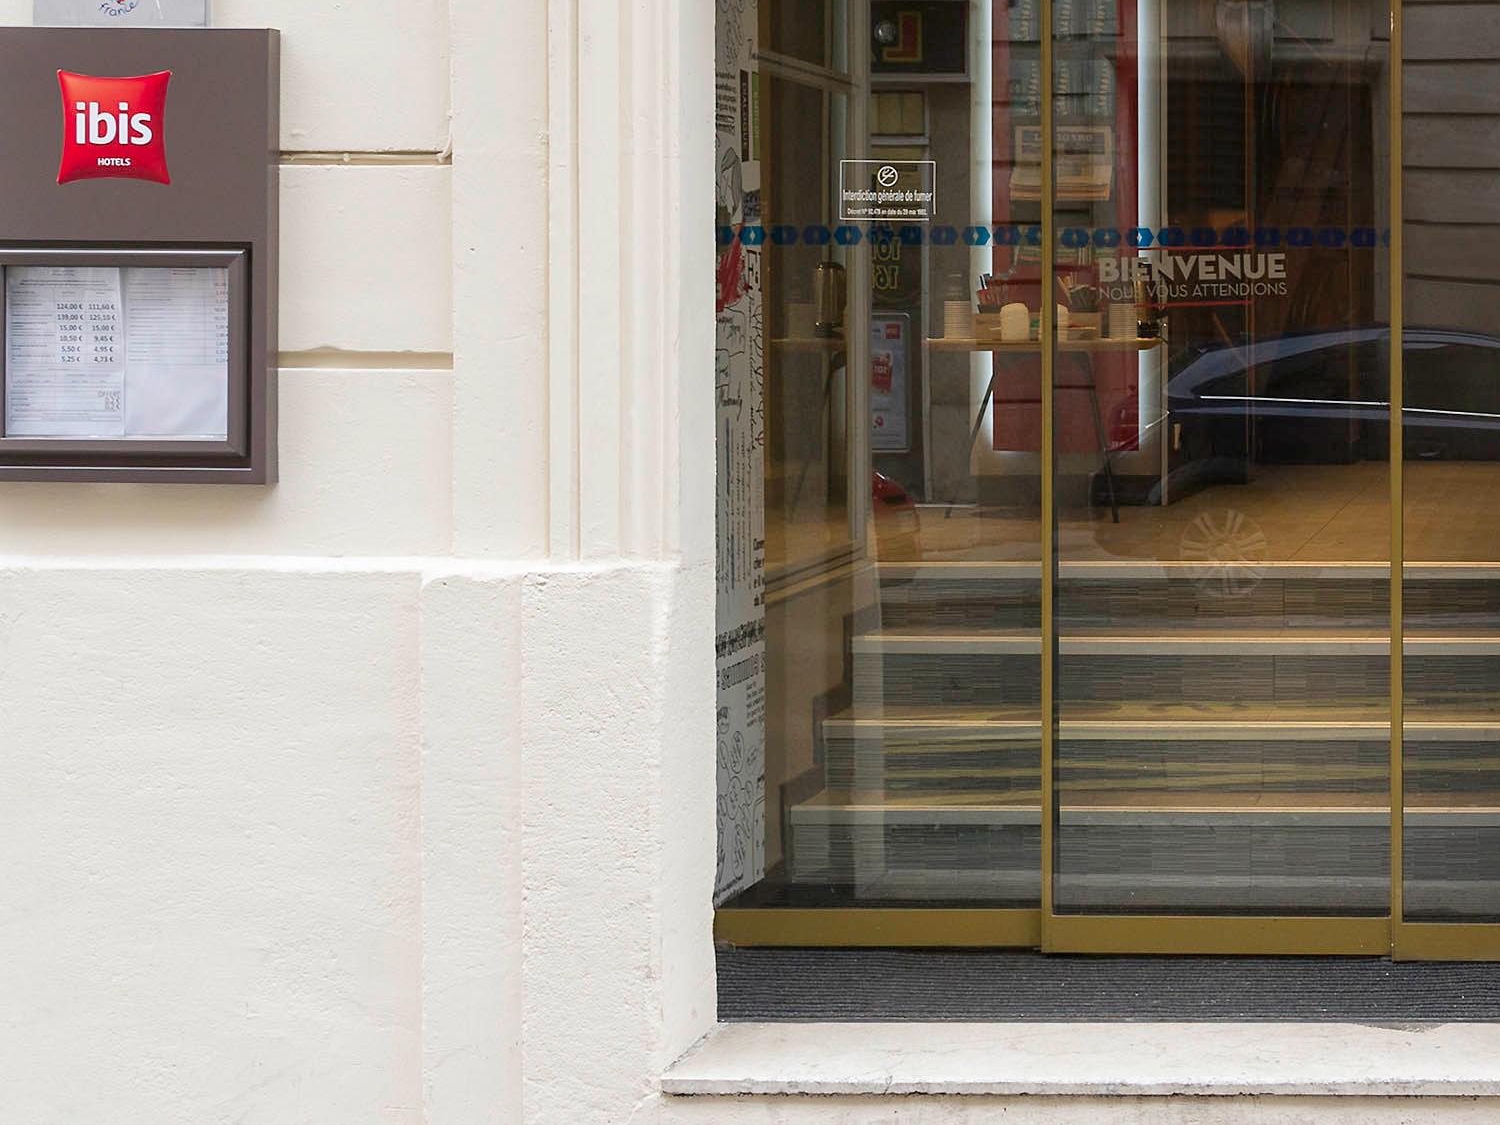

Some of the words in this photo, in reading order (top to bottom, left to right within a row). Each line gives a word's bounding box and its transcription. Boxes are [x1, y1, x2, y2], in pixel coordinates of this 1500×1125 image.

[75, 101, 153, 145] ibis
[97, 157, 132, 167] HOTELS
[842, 188, 877, 203] Interdiction
[877, 189, 904, 204] générale
[905, 189, 914, 203] de
[914, 189, 933, 203] fumer
[1099, 252, 1287, 283] BIENVENUE
[1147, 284, 1189, 298] VOUS
[1191, 282, 1288, 297] ATTENDIONS
